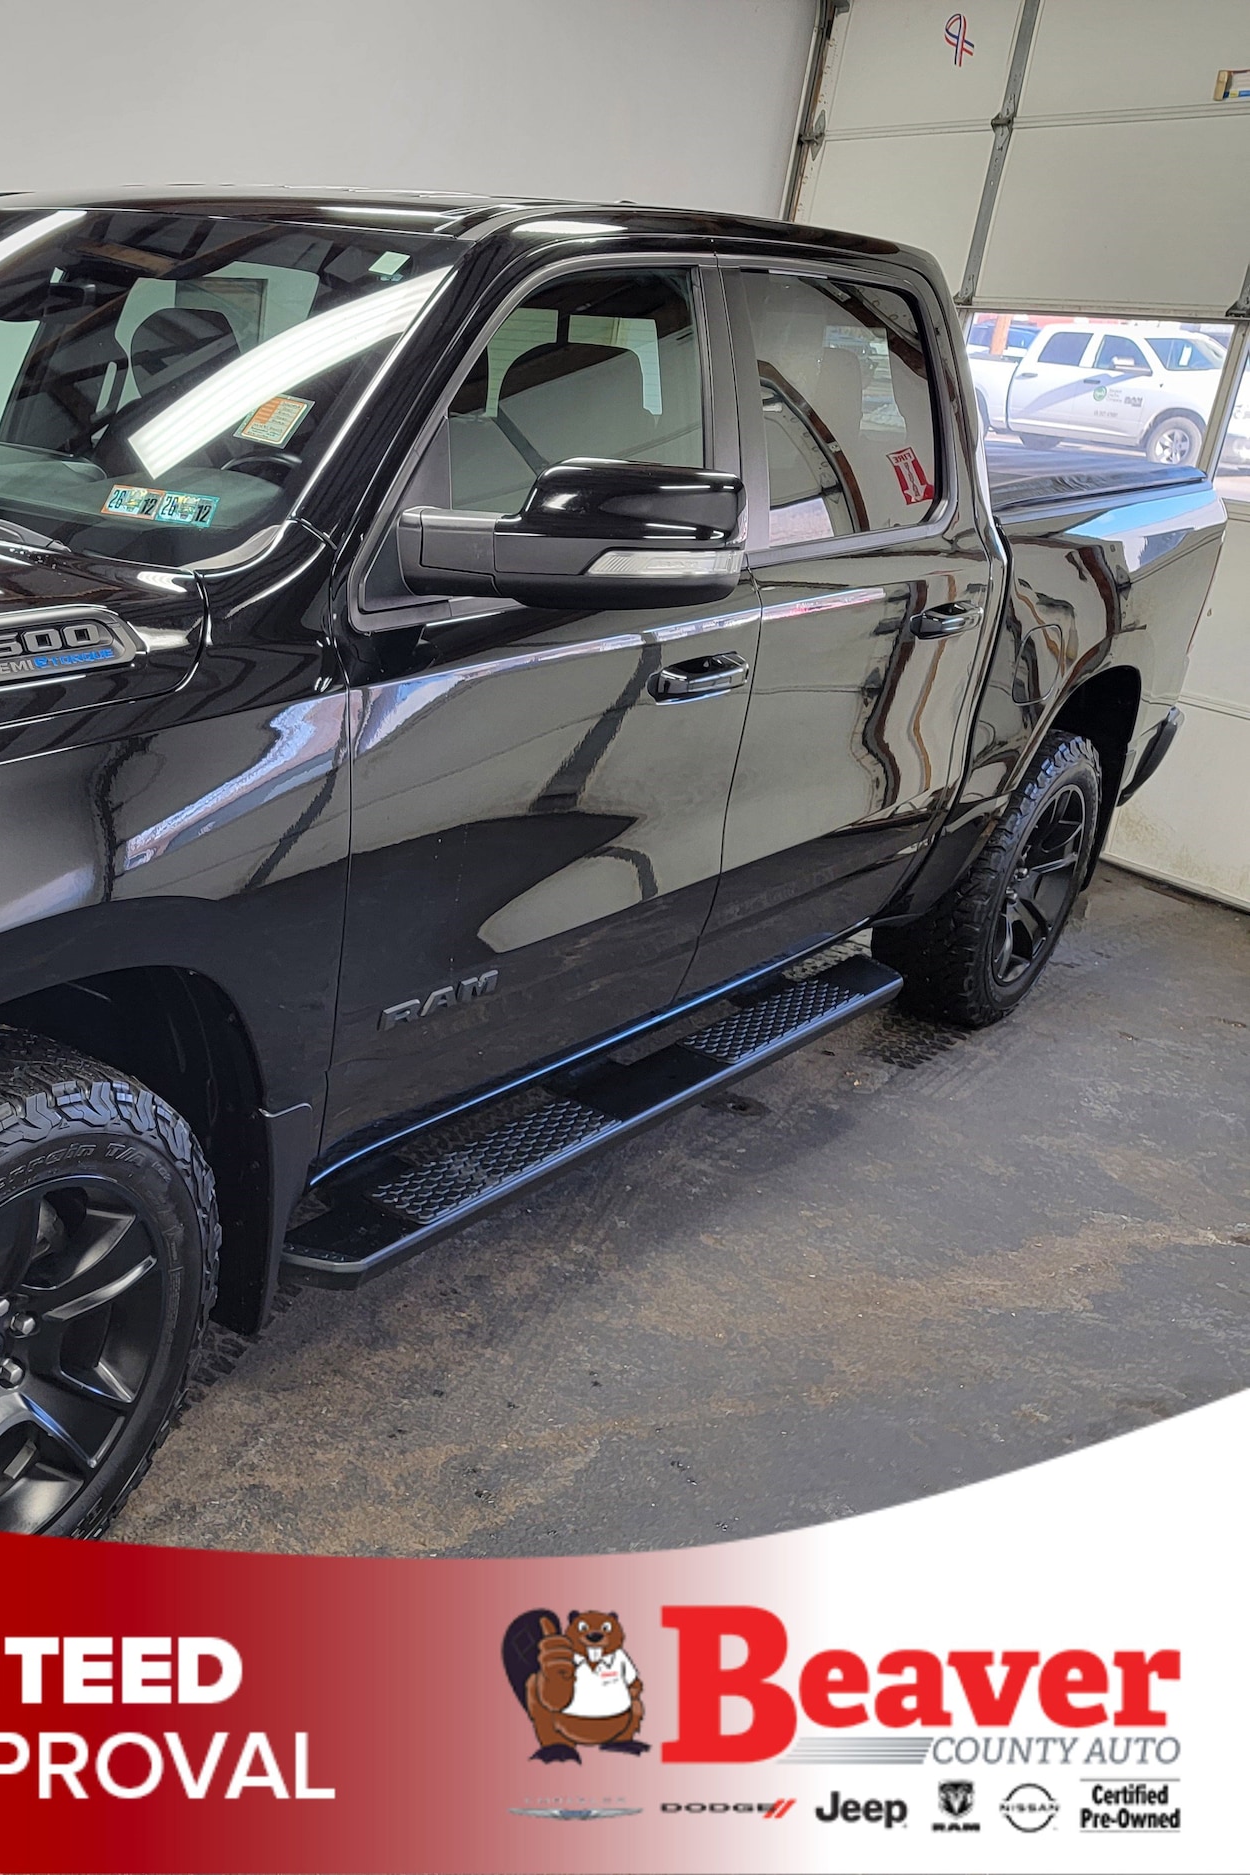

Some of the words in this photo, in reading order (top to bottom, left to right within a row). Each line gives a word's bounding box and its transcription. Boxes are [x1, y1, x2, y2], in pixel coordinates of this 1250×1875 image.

[141, 498, 158, 515] 12
[195, 504, 212, 522] 12
[377, 970, 499, 1032] RAM
